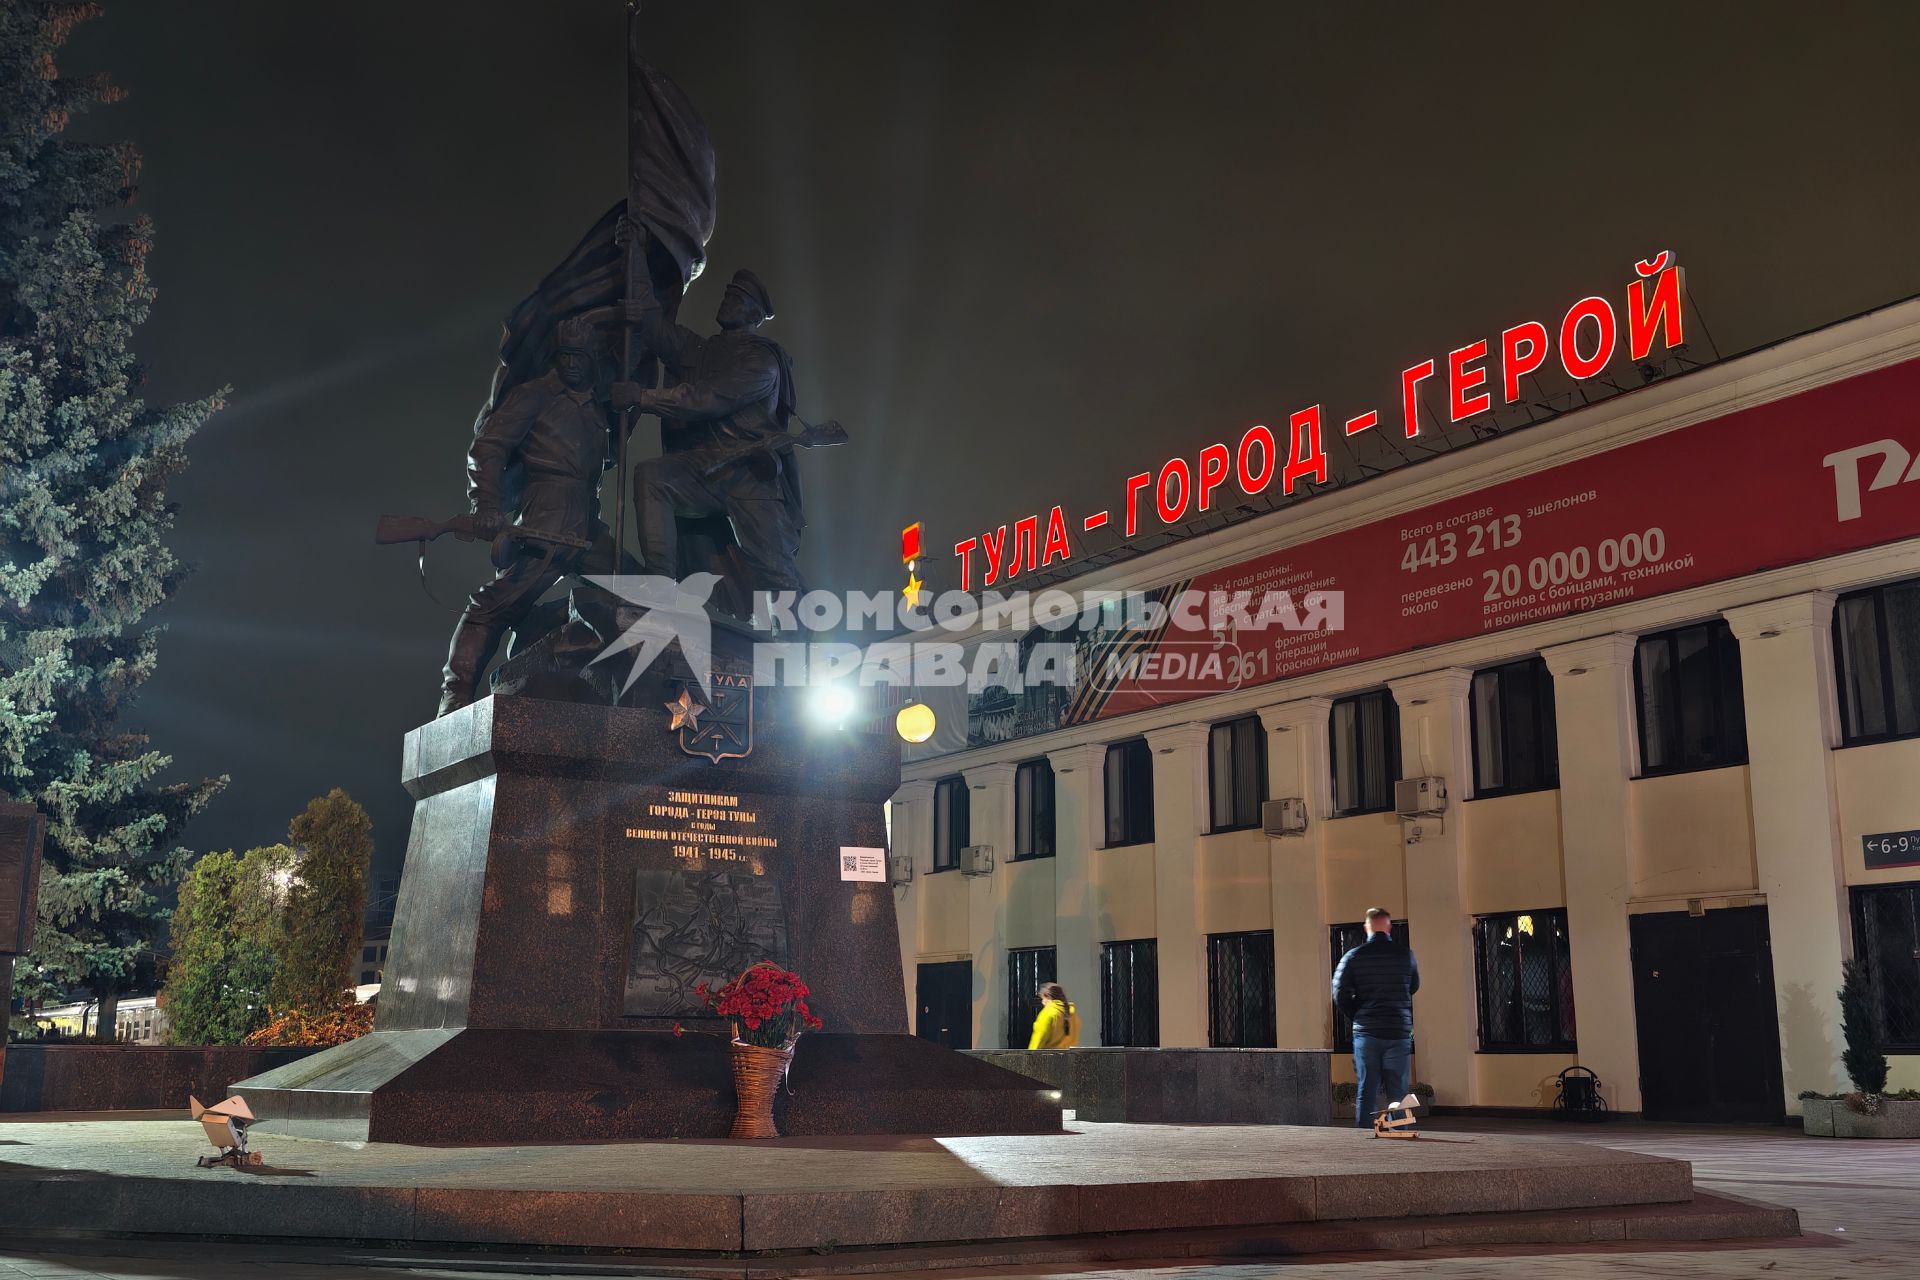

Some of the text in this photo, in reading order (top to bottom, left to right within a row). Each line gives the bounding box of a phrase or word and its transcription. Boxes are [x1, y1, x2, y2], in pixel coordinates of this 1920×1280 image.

[954, 505, 1071, 592] ТУЛА
[1125, 404, 1327, 537] ГОРОД
[1402, 250, 1683, 439] ГЕРОЙ
[1527, 490, 1597, 518] эшелонов
[1401, 506, 1494, 541] Всего в составе
[1401, 513, 1522, 573] 443 213
[1213, 563, 1293, 593] За 4 года войны:
[1482, 527, 1665, 602] 20 000 000
[1213, 569, 1313, 606] железнодорожники
[1272, 576, 1336, 602] проведение
[1401, 577, 1473, 603] перевезено
[1483, 553, 1694, 615] вагонов с бойцами, техникой
[1402, 600, 1438, 617] около
[1484, 585, 1634, 629] и воинскими грузами
[1213, 618, 1238, 650] 51
[1275, 624, 1334, 651] фронтовой
[1227, 648, 1268, 684] 261
[1275, 641, 1327, 663] операции
[1275, 646, 1360, 675] Красной Армии
[704, 672, 748, 688] ТУЛА
[668, 791, 738, 807] ЗАЩИТНИКАМ
[649, 804, 689, 819] ГОРОДА
[696, 808, 726, 821] ГЕРОЯ
[729, 810, 756, 823] ТУЛЫ
[626, 828, 778, 847] ВЕЛИКОЙ ОТЕЧЕСТВЕННОЙ ВОЙНЫ
[1881, 837, 1909, 854] 6-9
[672, 846, 700, 858] 1941
[709, 847, 736, 861] 1945
